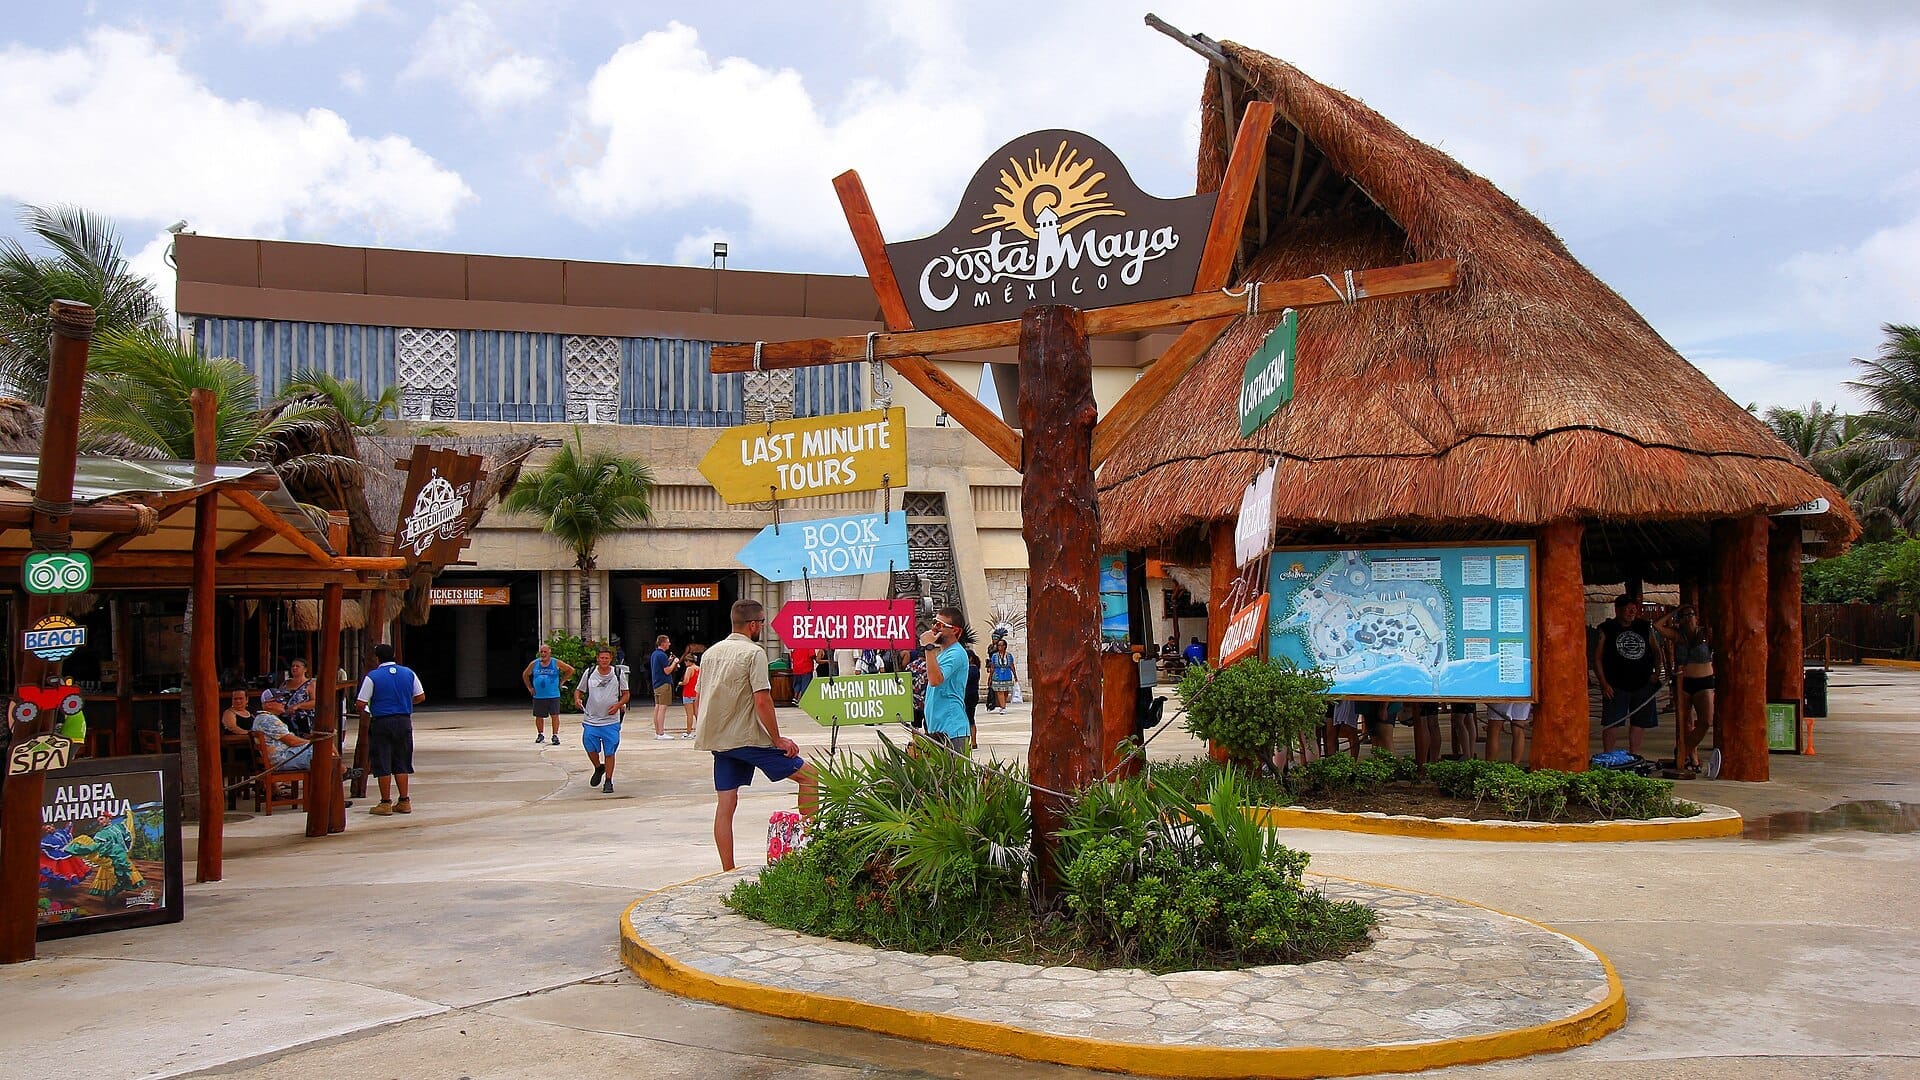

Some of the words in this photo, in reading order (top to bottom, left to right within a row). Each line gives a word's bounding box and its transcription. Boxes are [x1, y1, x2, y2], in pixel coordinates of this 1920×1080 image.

[919, 231, 1035, 311] Costa
[1050, 226, 1179, 285] Maya
[974, 273, 1108, 308] MÉXICO
[1244, 349, 1285, 416] CARTAGENA
[741, 432, 795, 466] LAST
[802, 421, 890, 459] MINUTE
[776, 456, 857, 491] TOURS
[413, 503, 456, 533] EXPEDITION
[802, 518, 880, 549] BOOK
[808, 545, 876, 575] NOW
[430, 589, 463, 599] TICKETS
[463, 589, 484, 599] HERE
[647, 588, 668, 599] PORT
[669, 587, 712, 598] ENTRANCE
[26, 629, 84, 649] BEACH
[793, 616, 847, 639] BEACH
[854, 615, 910, 640] BREAK
[821, 682, 864, 700] MAYAN
[869, 678, 906, 698] RUINS
[844, 700, 884, 720] TOURS
[12, 749, 65, 773] SPA
[54, 783, 115, 804] ALDEA
[42, 799, 131, 823] MAHAHUA
